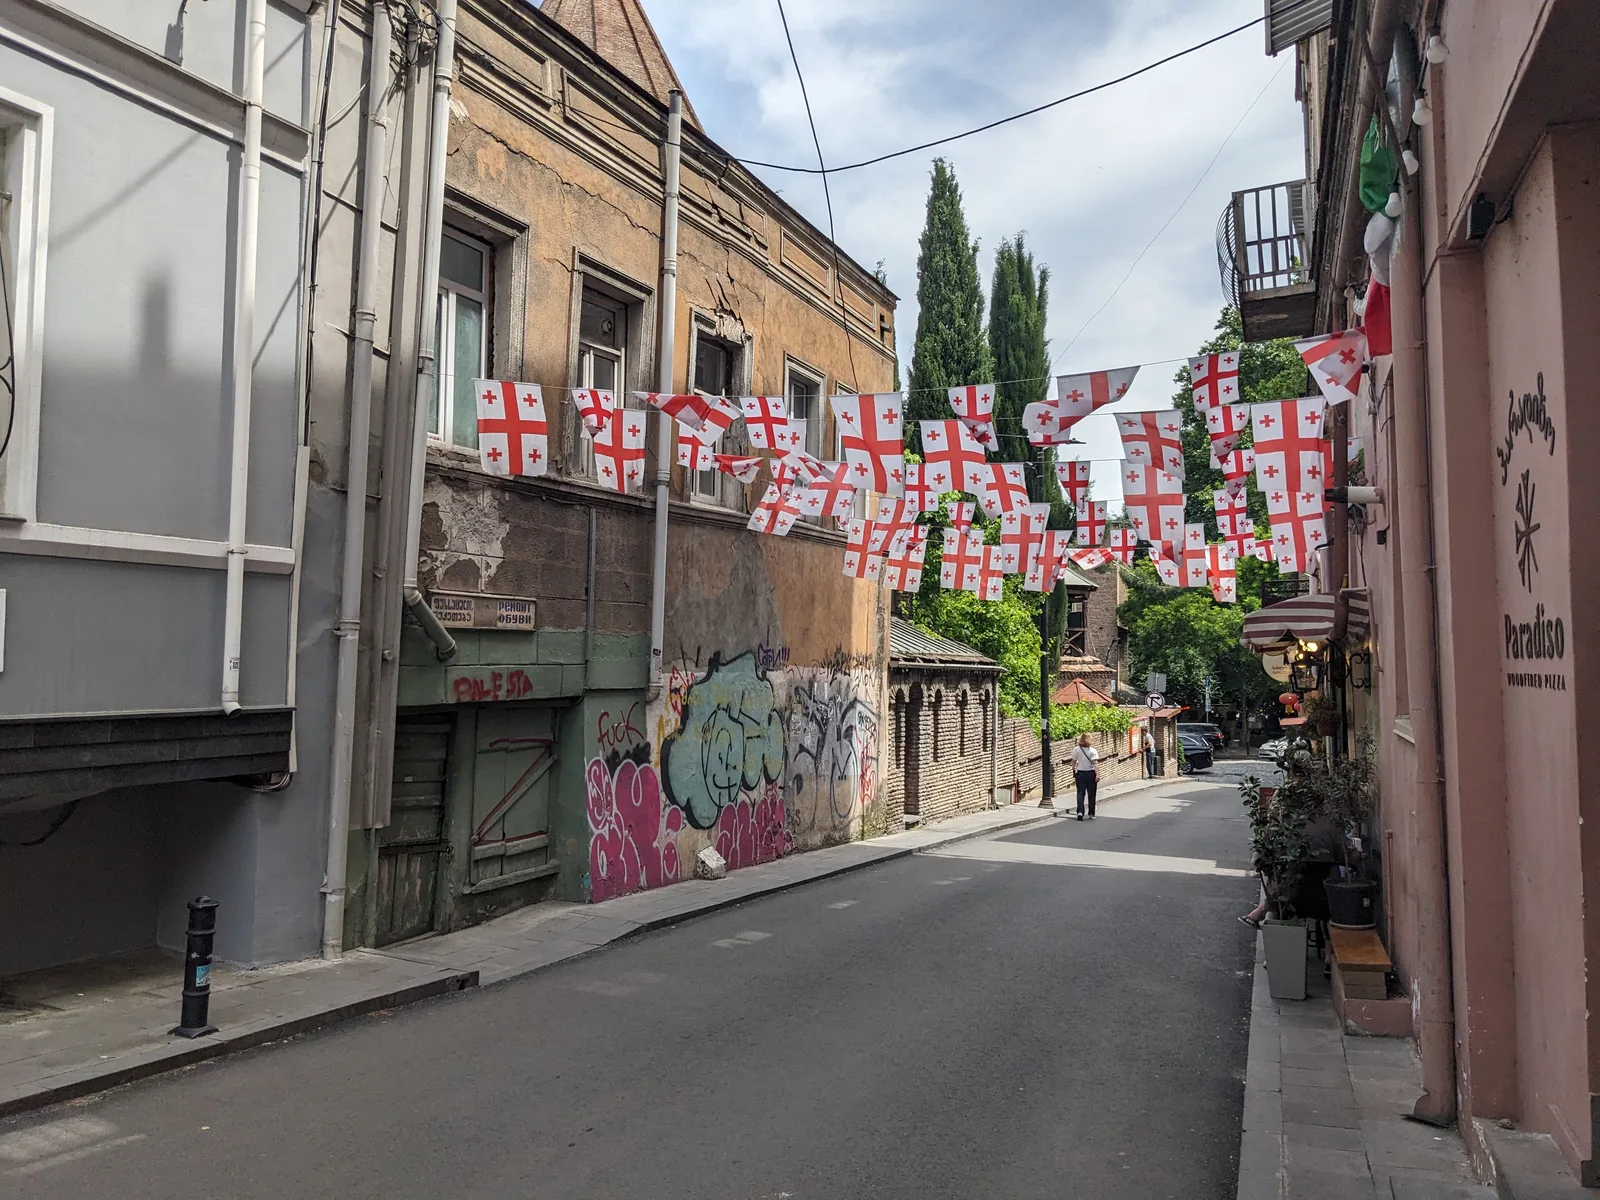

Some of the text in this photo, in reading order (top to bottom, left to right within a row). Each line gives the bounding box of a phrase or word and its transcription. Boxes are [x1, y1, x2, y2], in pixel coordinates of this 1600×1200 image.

[499, 613, 531, 625] ОБУВИ
[1504, 603, 1564, 660] Paradiso
[1507, 672, 1567, 692] WOODFIRED PIZZA
